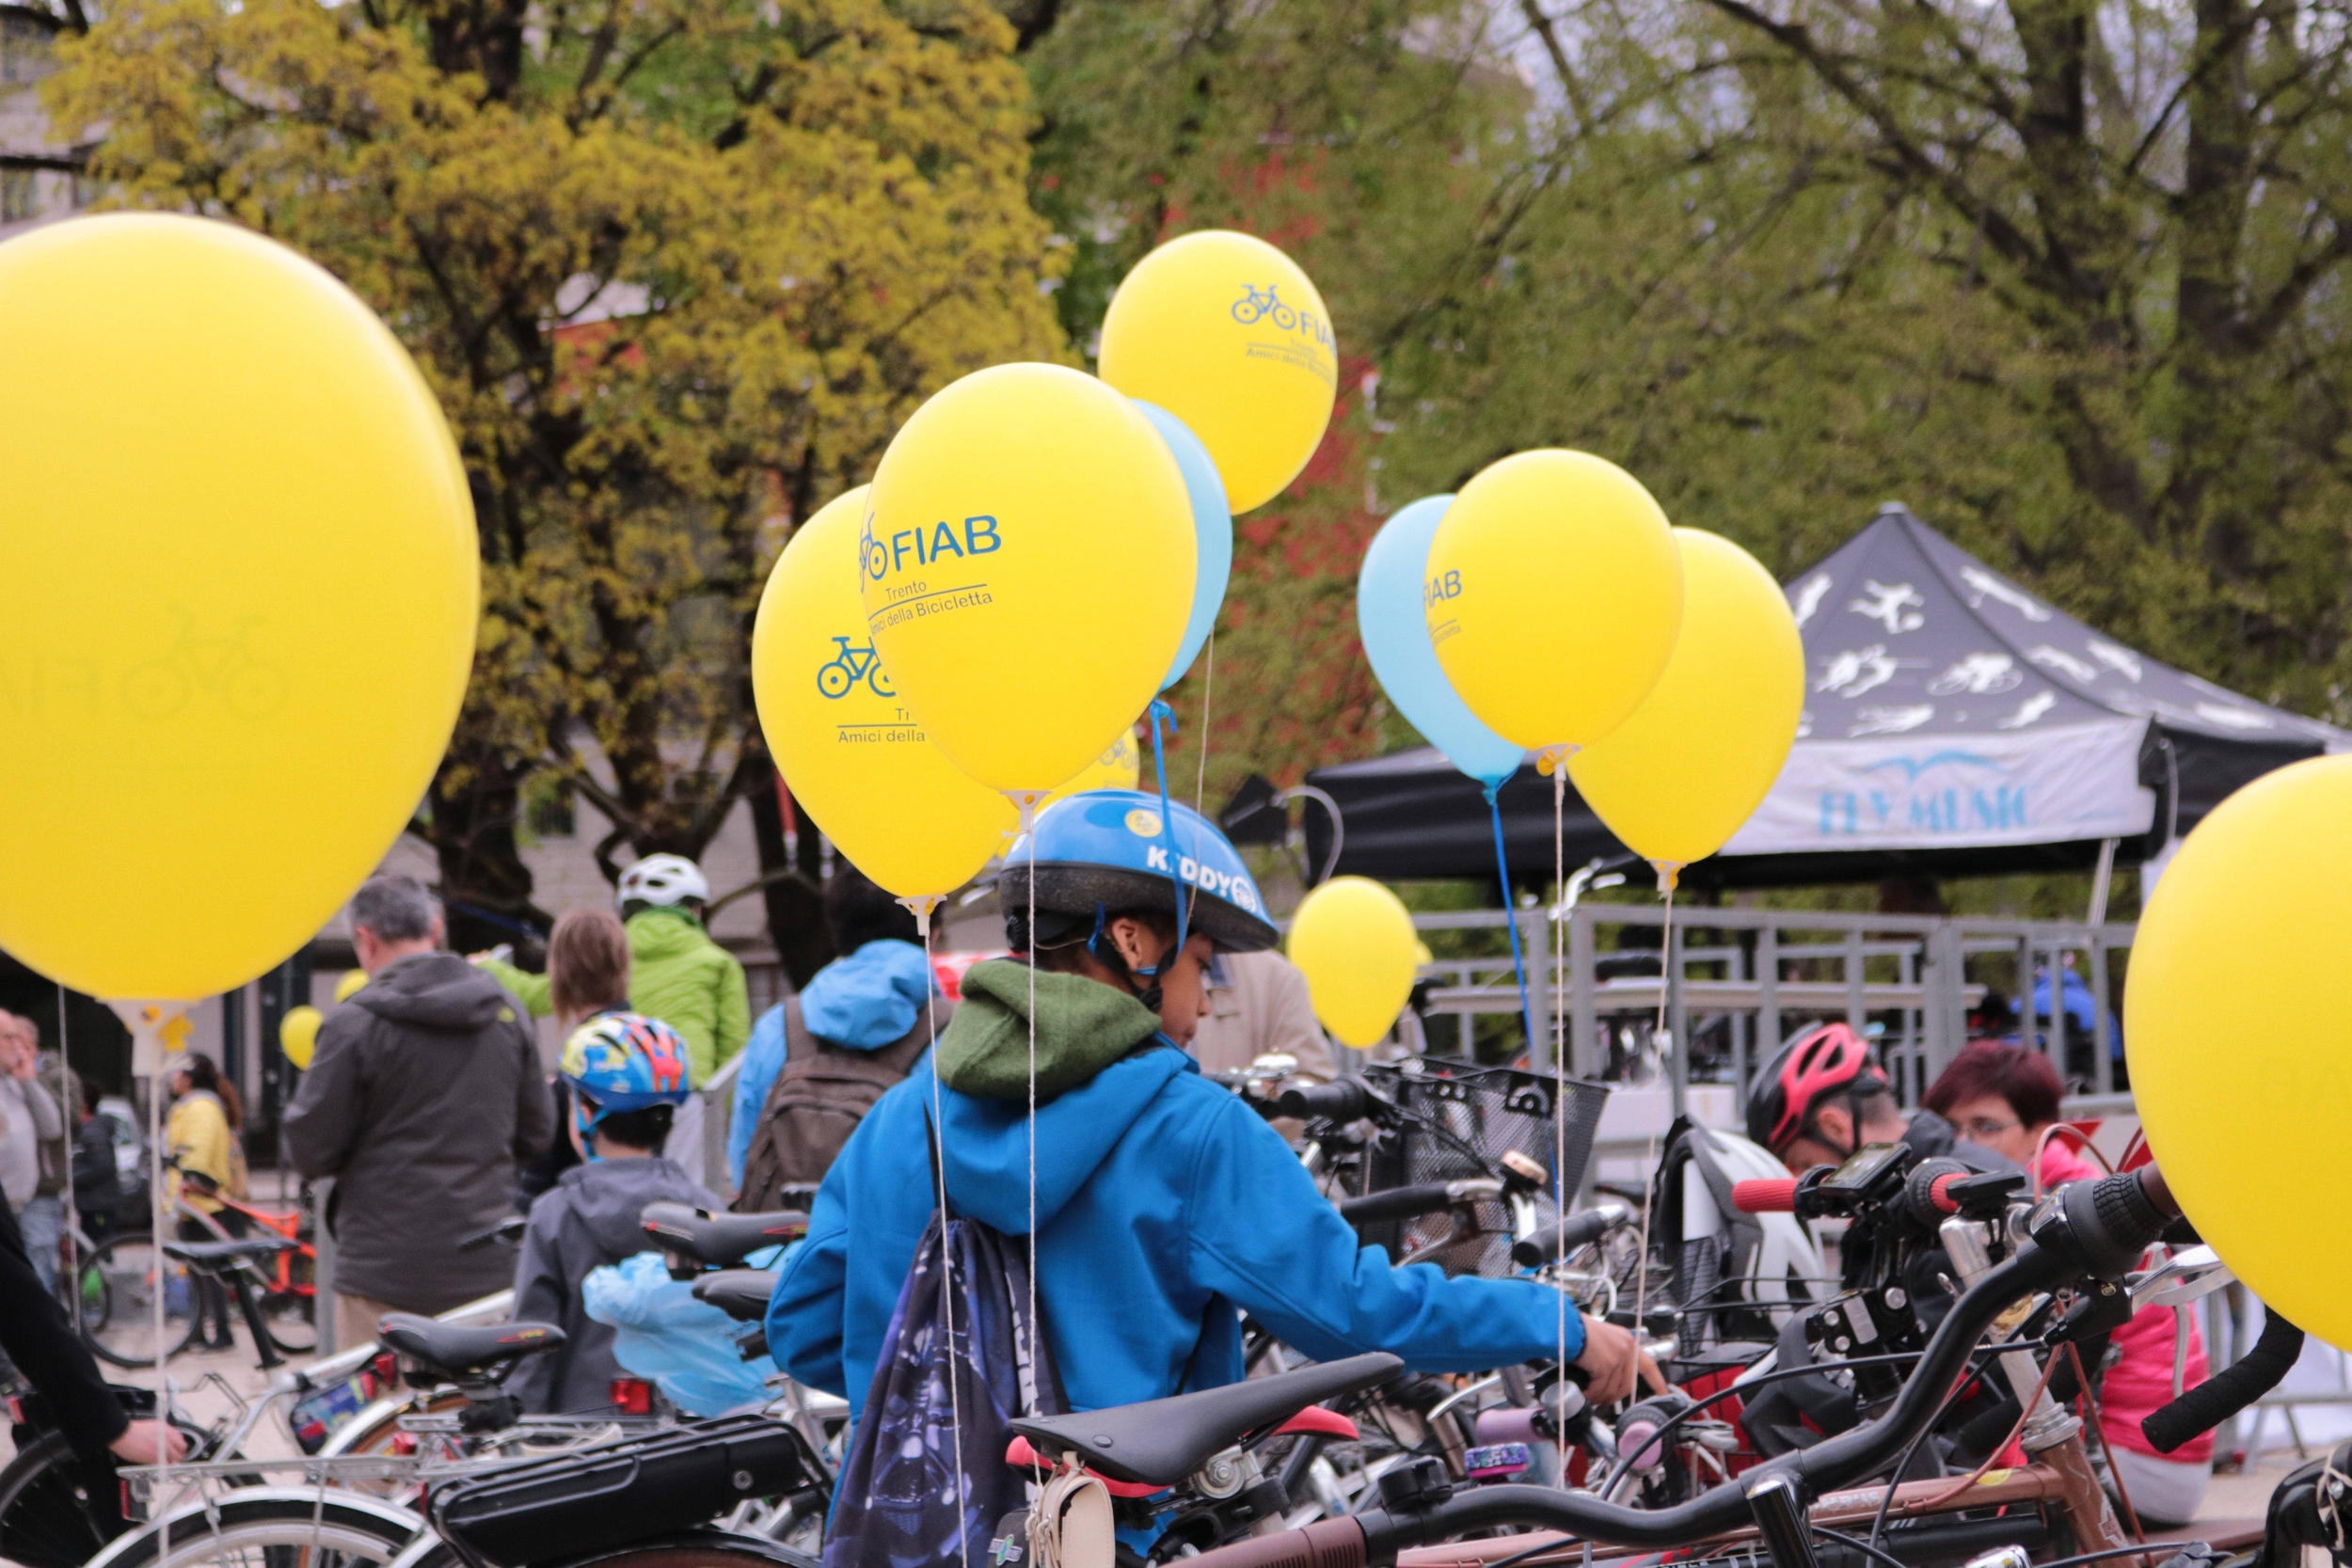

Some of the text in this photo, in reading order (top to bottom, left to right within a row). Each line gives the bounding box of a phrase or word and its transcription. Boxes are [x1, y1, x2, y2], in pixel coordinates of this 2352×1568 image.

[892, 515, 1002, 572] FIAB
[885, 580, 927, 602] Trento
[887, 608, 914, 627] della
[915, 592, 993, 617] Bicicletta
[838, 729, 925, 744] Amici della
[1820, 784, 2030, 835] FLY MUSIC
[1147, 845, 1232, 897] KDDY
